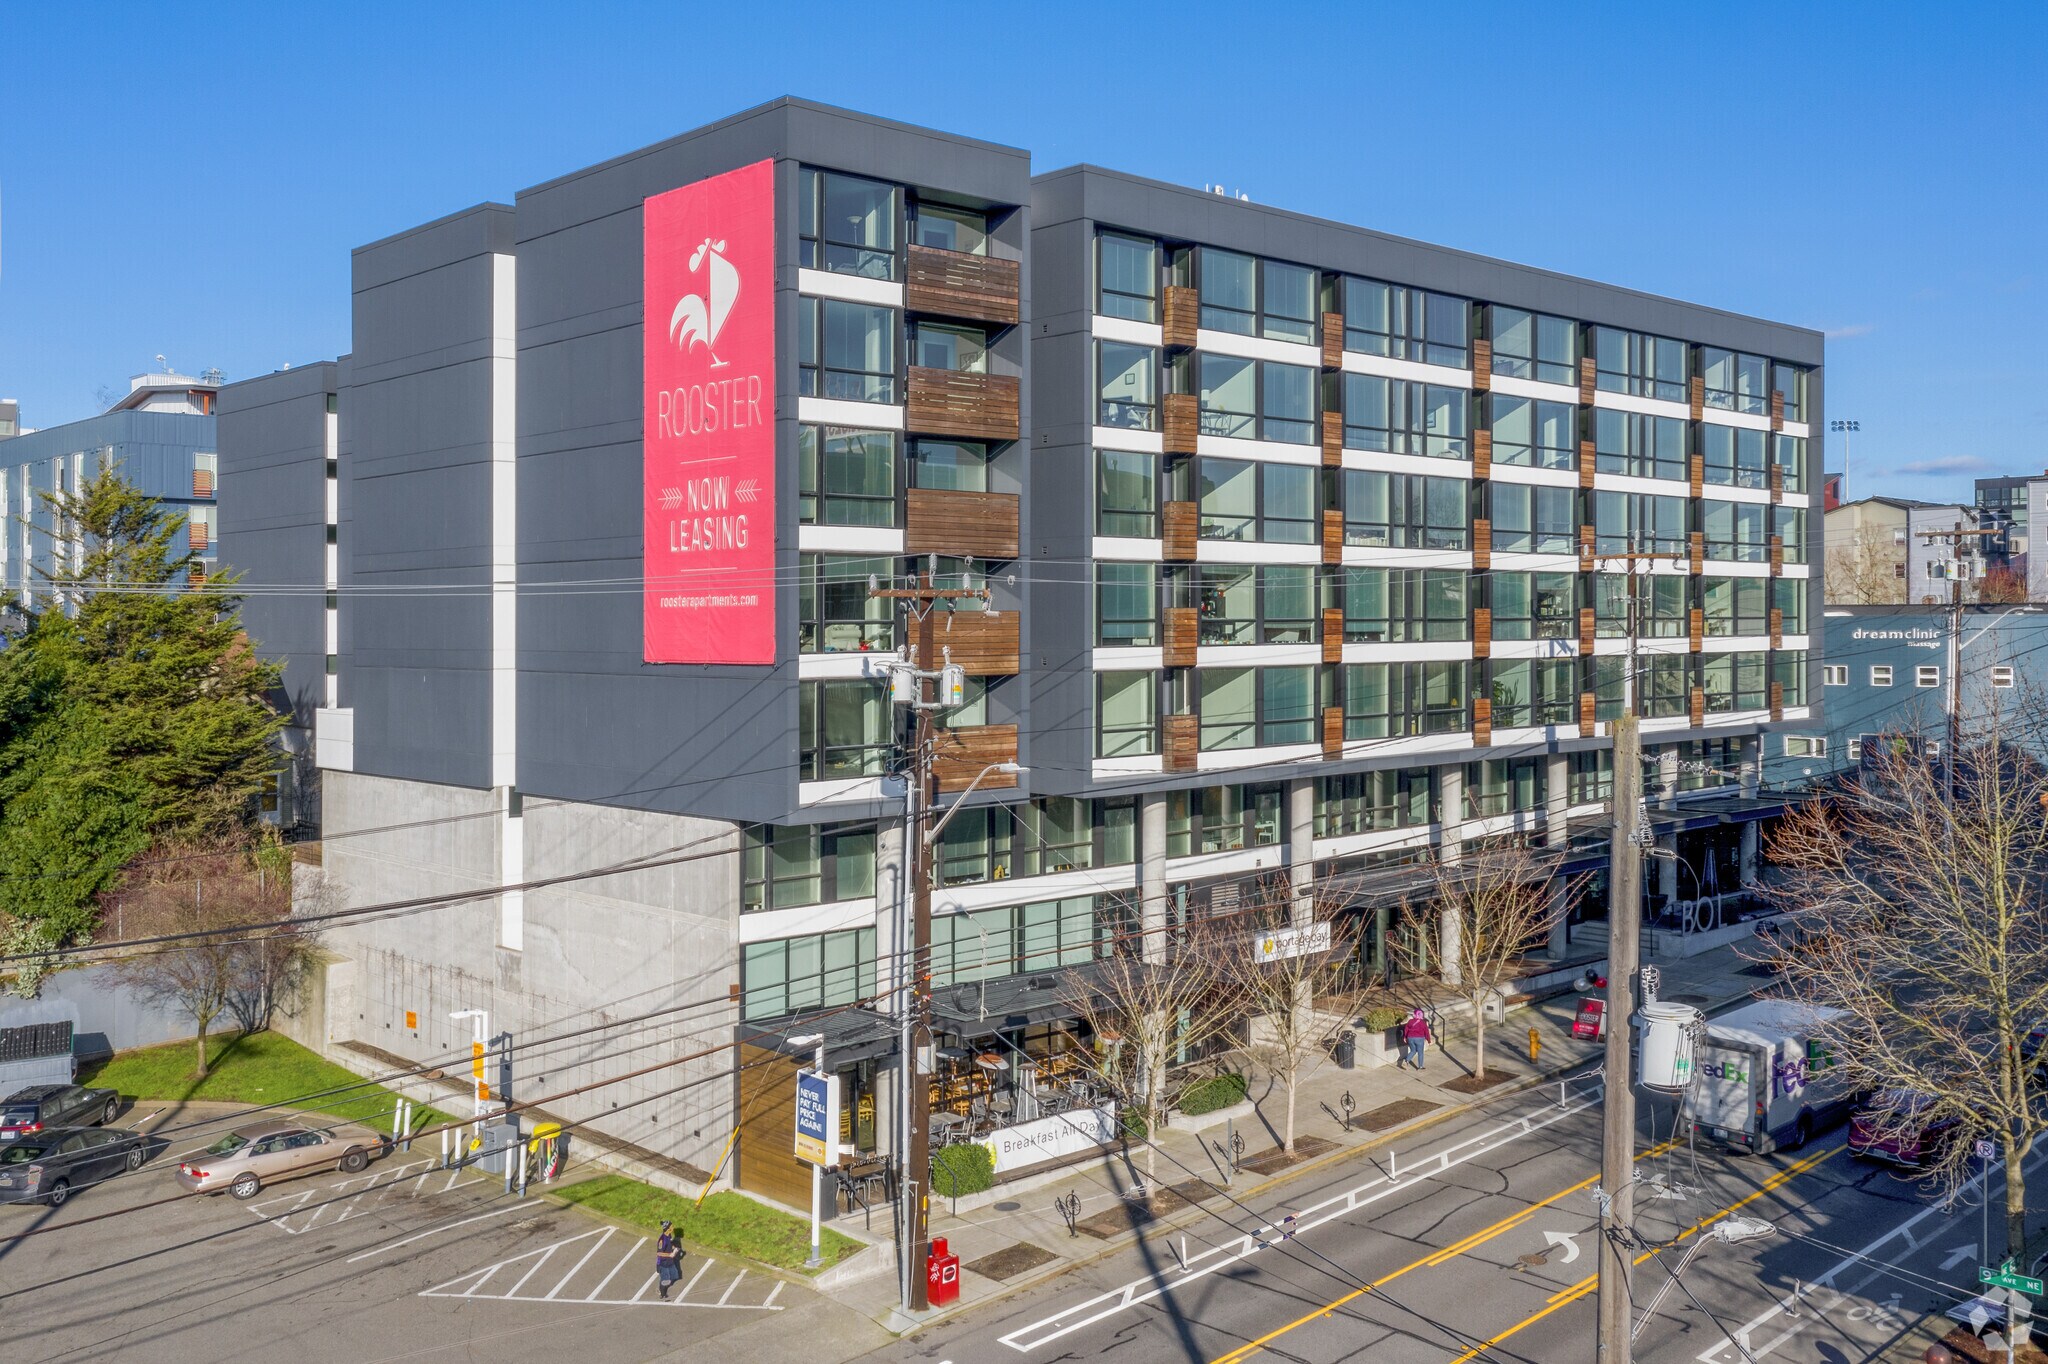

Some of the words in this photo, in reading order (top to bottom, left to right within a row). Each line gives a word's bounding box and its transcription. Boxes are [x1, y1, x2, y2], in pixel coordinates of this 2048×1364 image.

[658, 375, 762, 439] ROOSTER
[687, 475, 730, 512] NOW
[670, 514, 749, 553] LEASING
[660, 593, 759, 610] roosterapartments.com
[1853, 628, 1940, 639] dreamclinic
[800, 1088, 819, 1102] NEVER
[799, 1097, 811, 1109] PAY
[812, 1103, 826, 1114] FULL
[800, 1109, 816, 1120] PRICE
[1003, 1129, 1058, 1153] Breakfast
[1061, 1124, 1077, 1138] All
[1080, 1121, 1100, 1134] Day
[2002, 1277, 2016, 1285] AVE
[2026, 1281, 2039, 1290] NE
